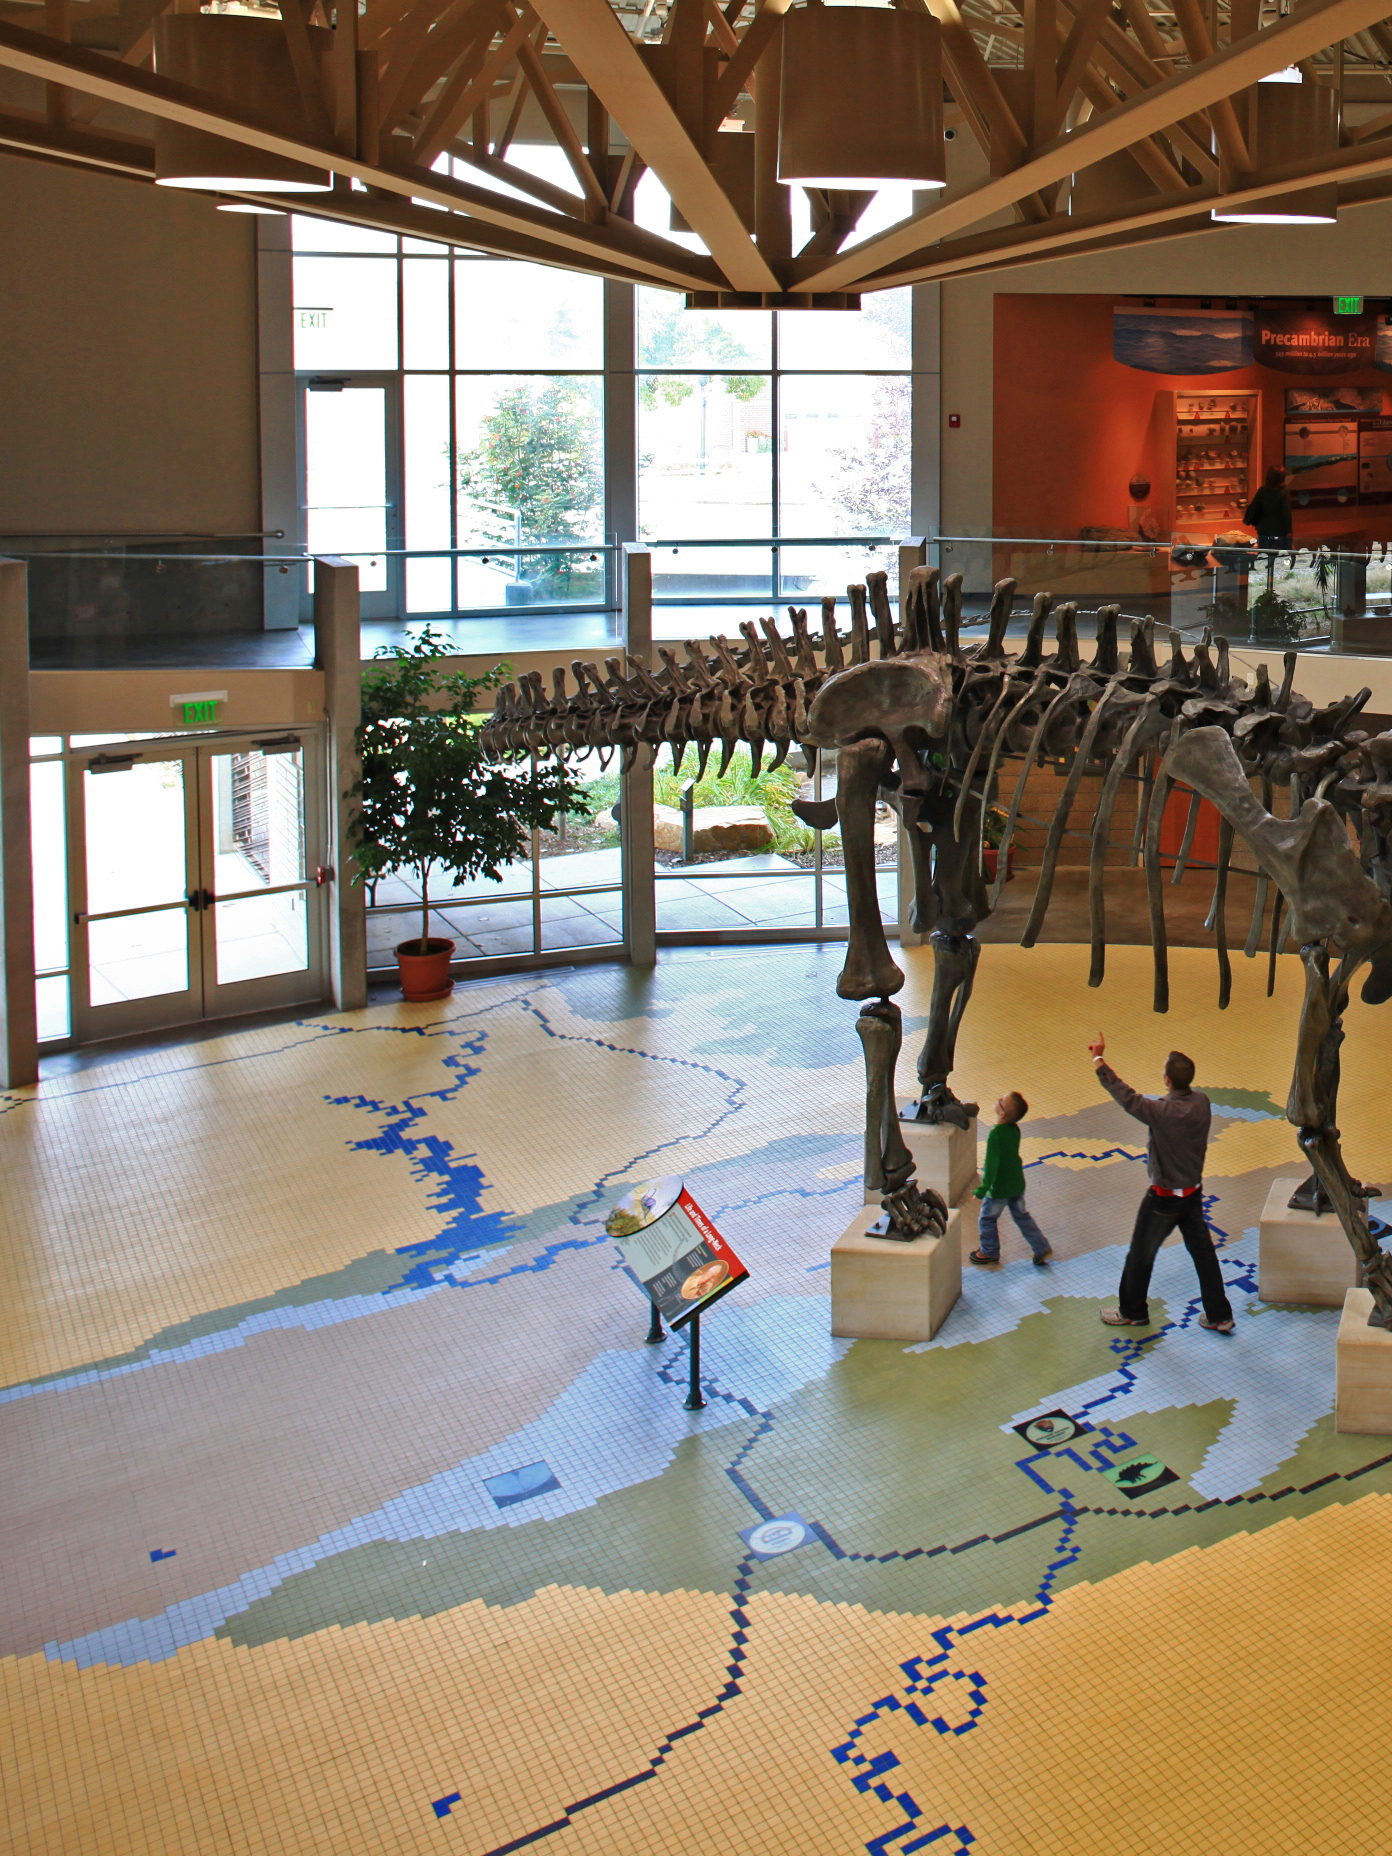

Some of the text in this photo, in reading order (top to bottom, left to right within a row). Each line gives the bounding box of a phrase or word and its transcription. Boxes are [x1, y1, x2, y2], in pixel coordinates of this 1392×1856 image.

[1338, 297, 1360, 313] EXIT
[301, 312, 327, 328] EXIT
[1261, 330, 1370, 347] Precambrian Era
[184, 700, 218, 723] EXIT
[693, 1214, 704, 1228] Times
